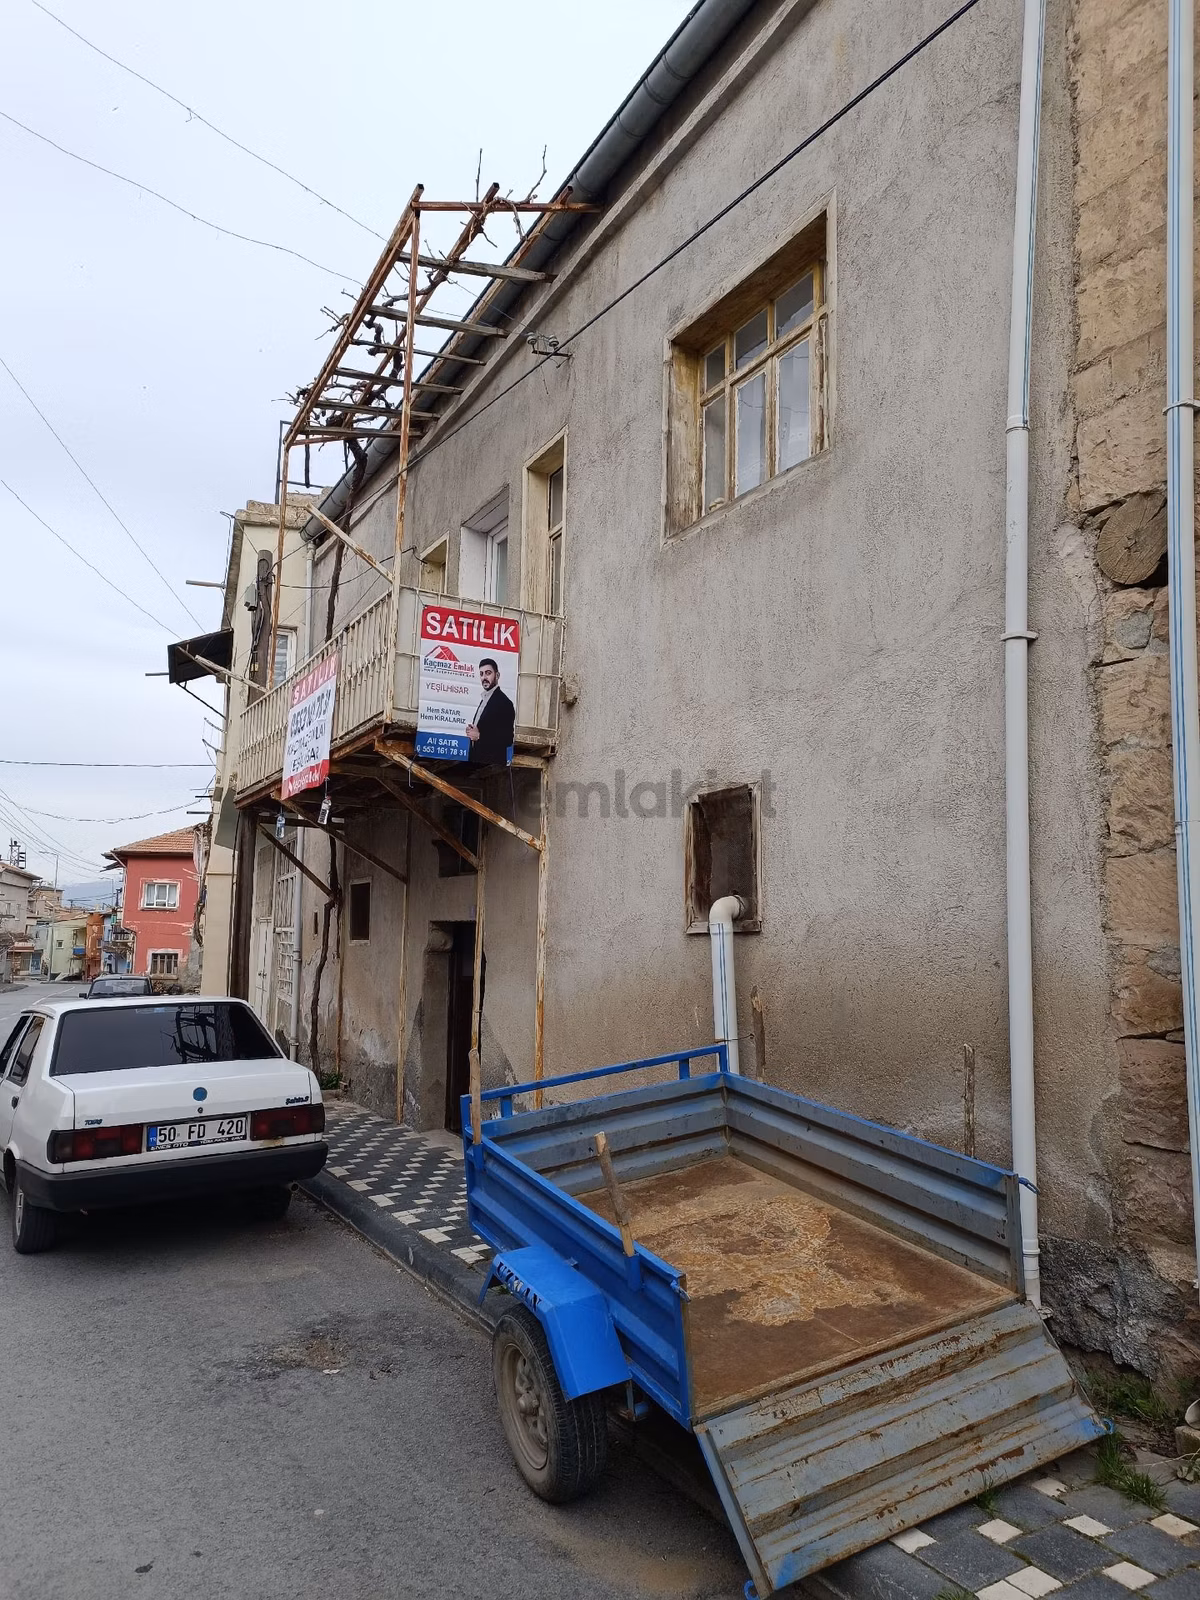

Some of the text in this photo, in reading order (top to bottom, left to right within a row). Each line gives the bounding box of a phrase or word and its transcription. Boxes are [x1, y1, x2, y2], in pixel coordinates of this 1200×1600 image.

[426, 611, 516, 648] SATILIK
[423, 658, 452, 670] Kaçmaz
[453, 662, 475, 673] Emlak
[420, 713, 434, 721] Hem
[426, 706, 461, 717] Hem SATAR
[422, 745, 435, 754] 553
[436, 746, 448, 755] 161
[450, 748, 458, 756] 78
[459, 749, 467, 757] 31
[158, 1119, 243, 1143] 50 FD 420
